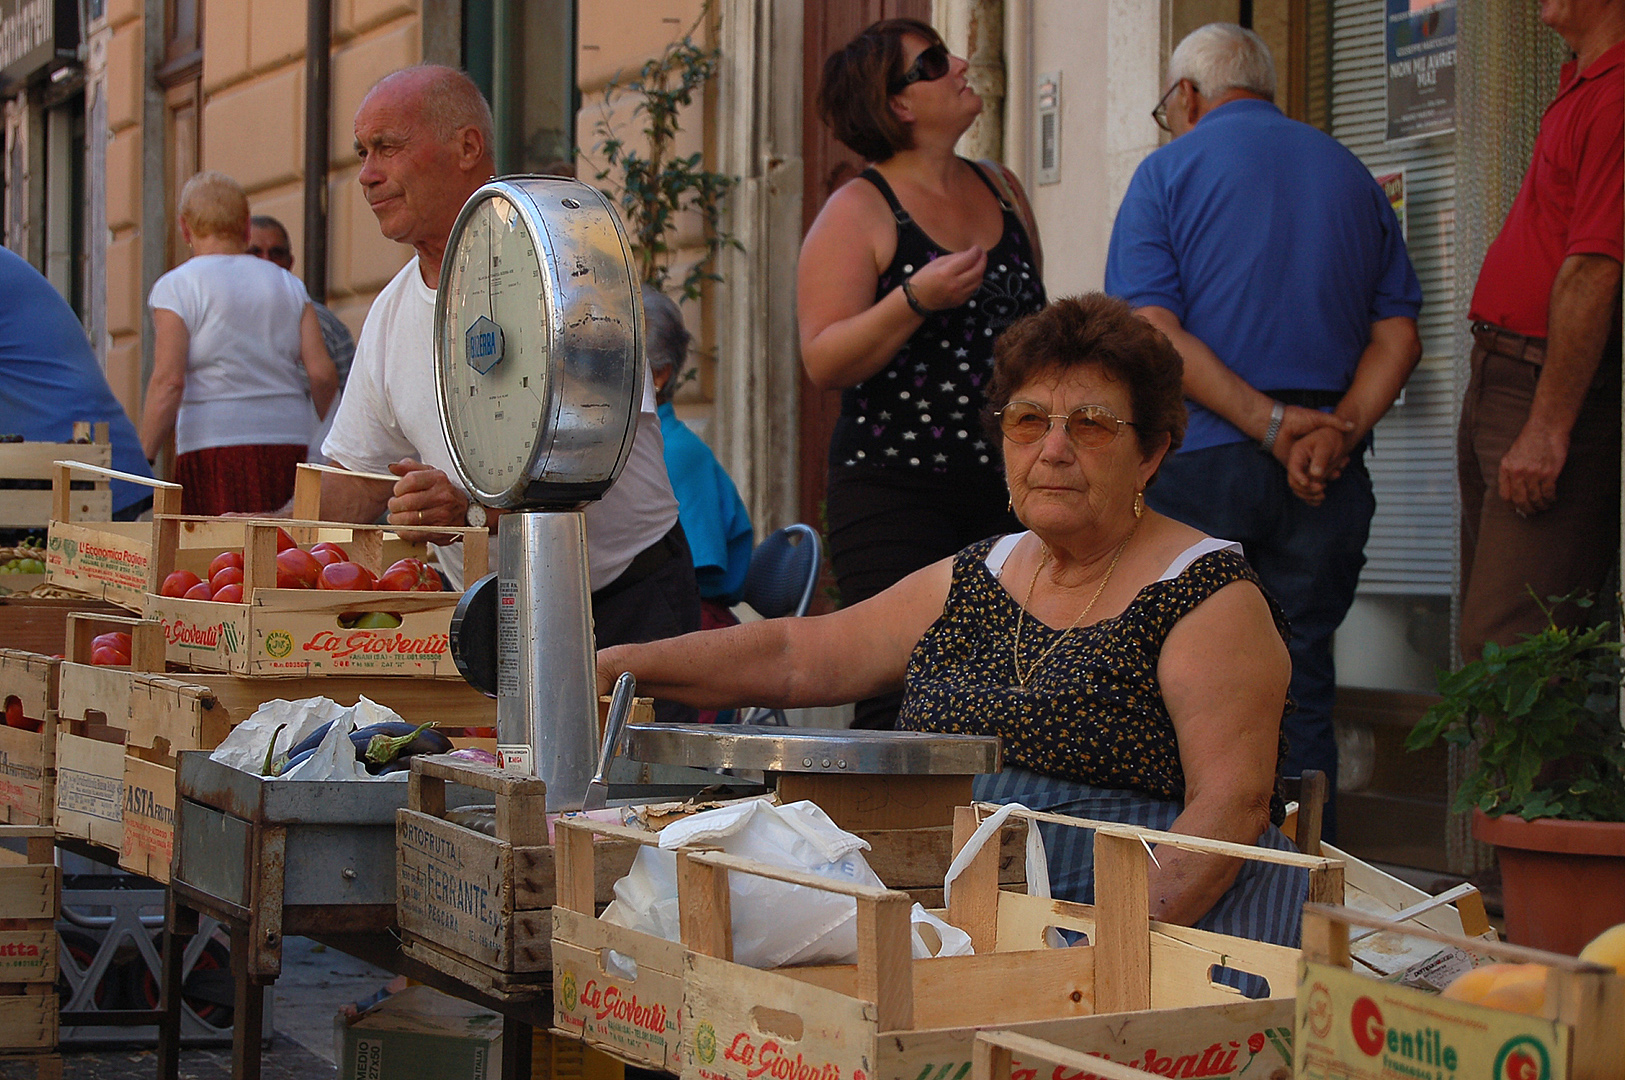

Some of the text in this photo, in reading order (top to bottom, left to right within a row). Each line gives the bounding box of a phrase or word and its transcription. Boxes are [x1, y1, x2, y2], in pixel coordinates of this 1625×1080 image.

[470, 332, 496, 358] BIZERBA
[123, 550, 148, 567] Pagliare
[169, 620, 218, 646] Gioventù
[303, 630, 449, 659] La Gioventù
[402, 821, 456, 861] ORTOFRUTTA
[427, 863, 488, 923] FERRANTE
[581, 979, 602, 1009] La
[596, 986, 667, 1034] Gioventù
[1351, 996, 1458, 1072] Gentile
[357, 1041, 369, 1080] MEDIO
[474, 1050, 483, 1073] ITALIA
[724, 1032, 842, 1080] La Gioventù
